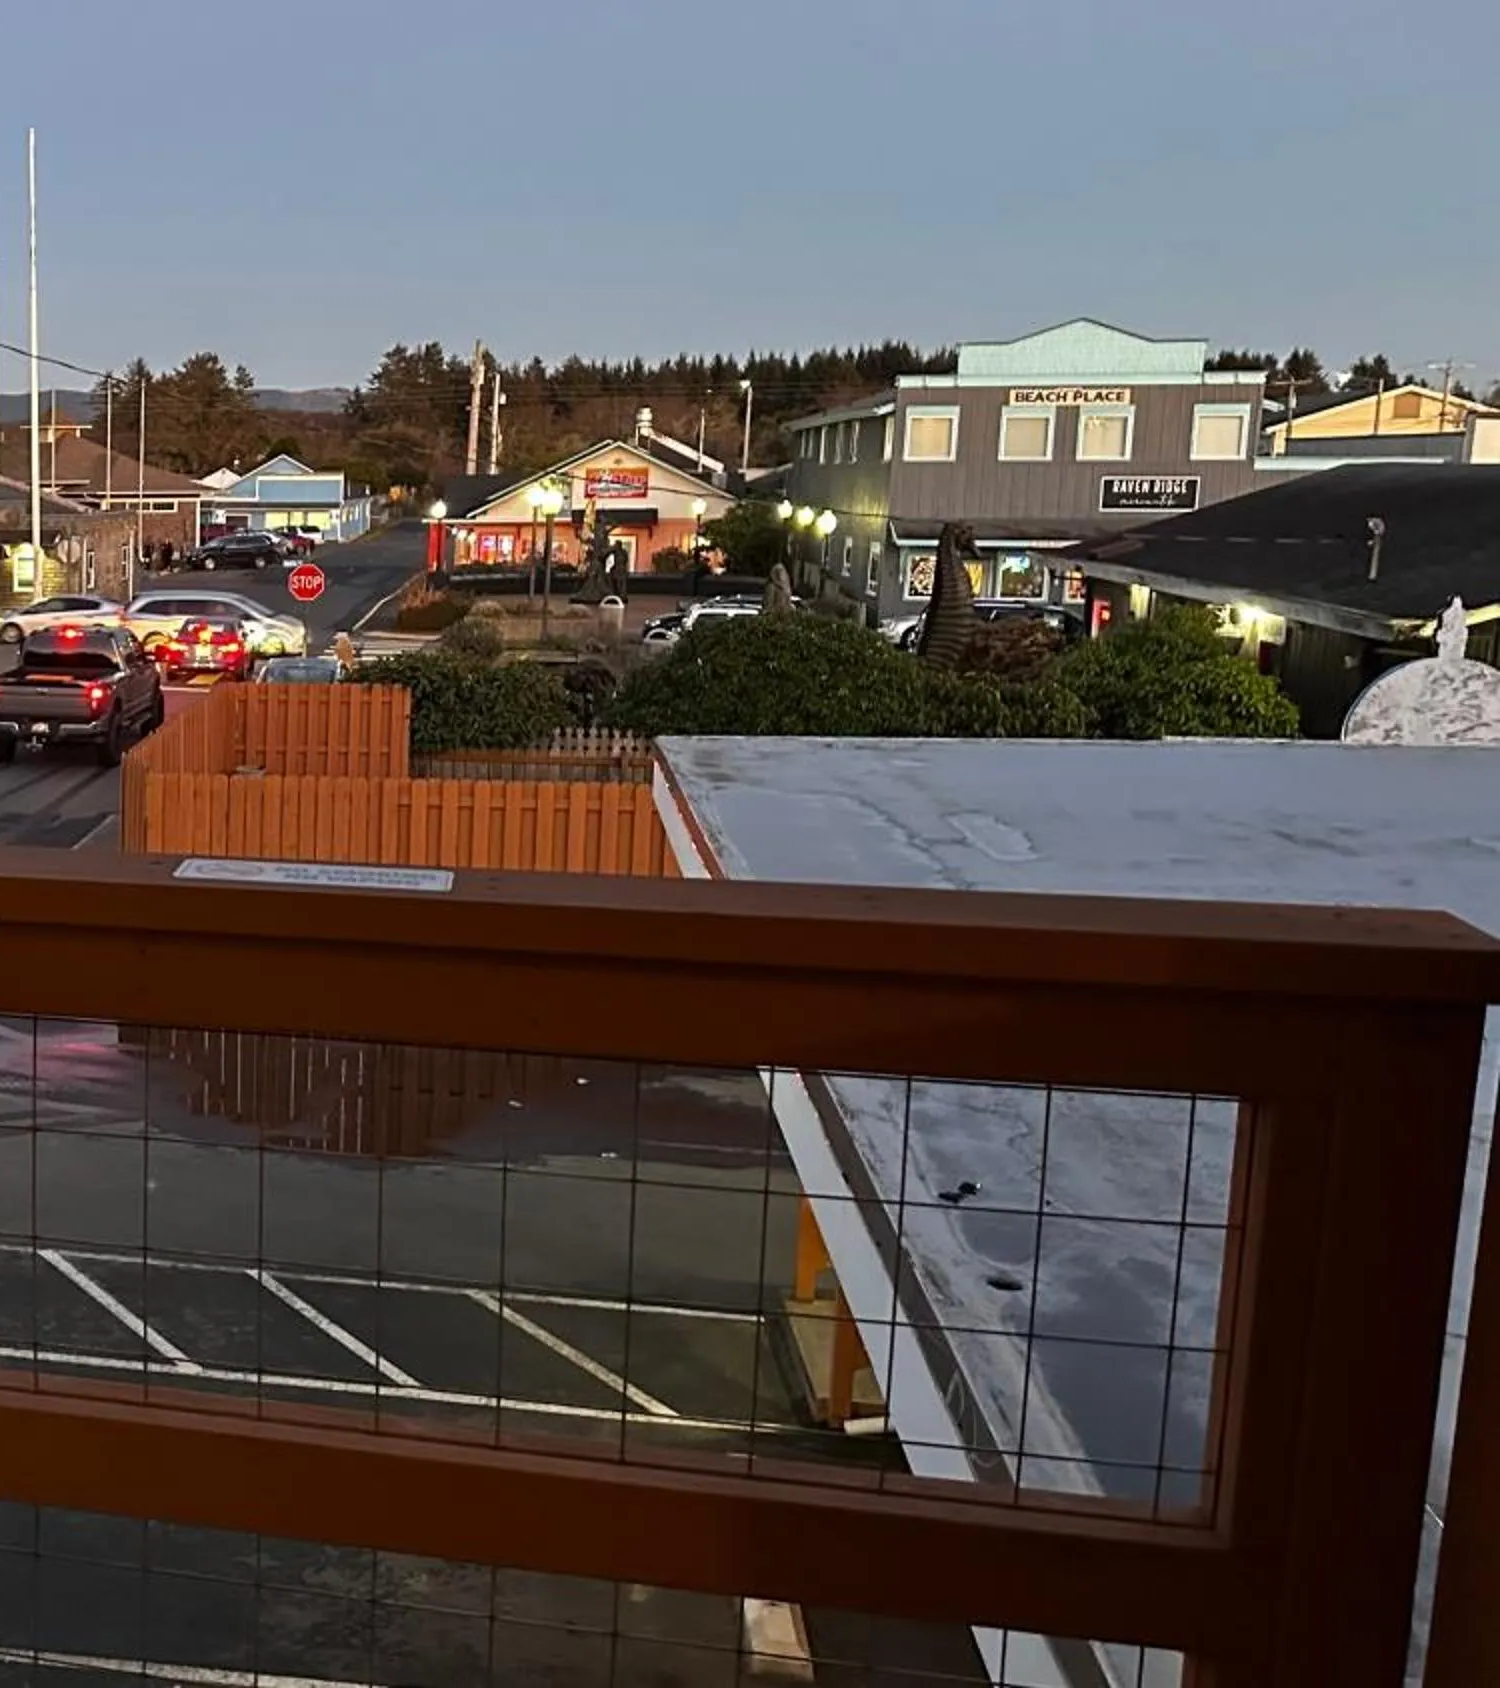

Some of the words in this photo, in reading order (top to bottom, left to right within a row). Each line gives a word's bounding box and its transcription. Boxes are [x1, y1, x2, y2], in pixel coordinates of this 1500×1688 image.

[1014, 391, 1067, 403] BEACH
[1073, 390, 1125, 403] PLACE
[1112, 480, 1150, 494] RAVEN
[1153, 480, 1188, 494] RIDGE
[292, 575, 321, 589] STOP
